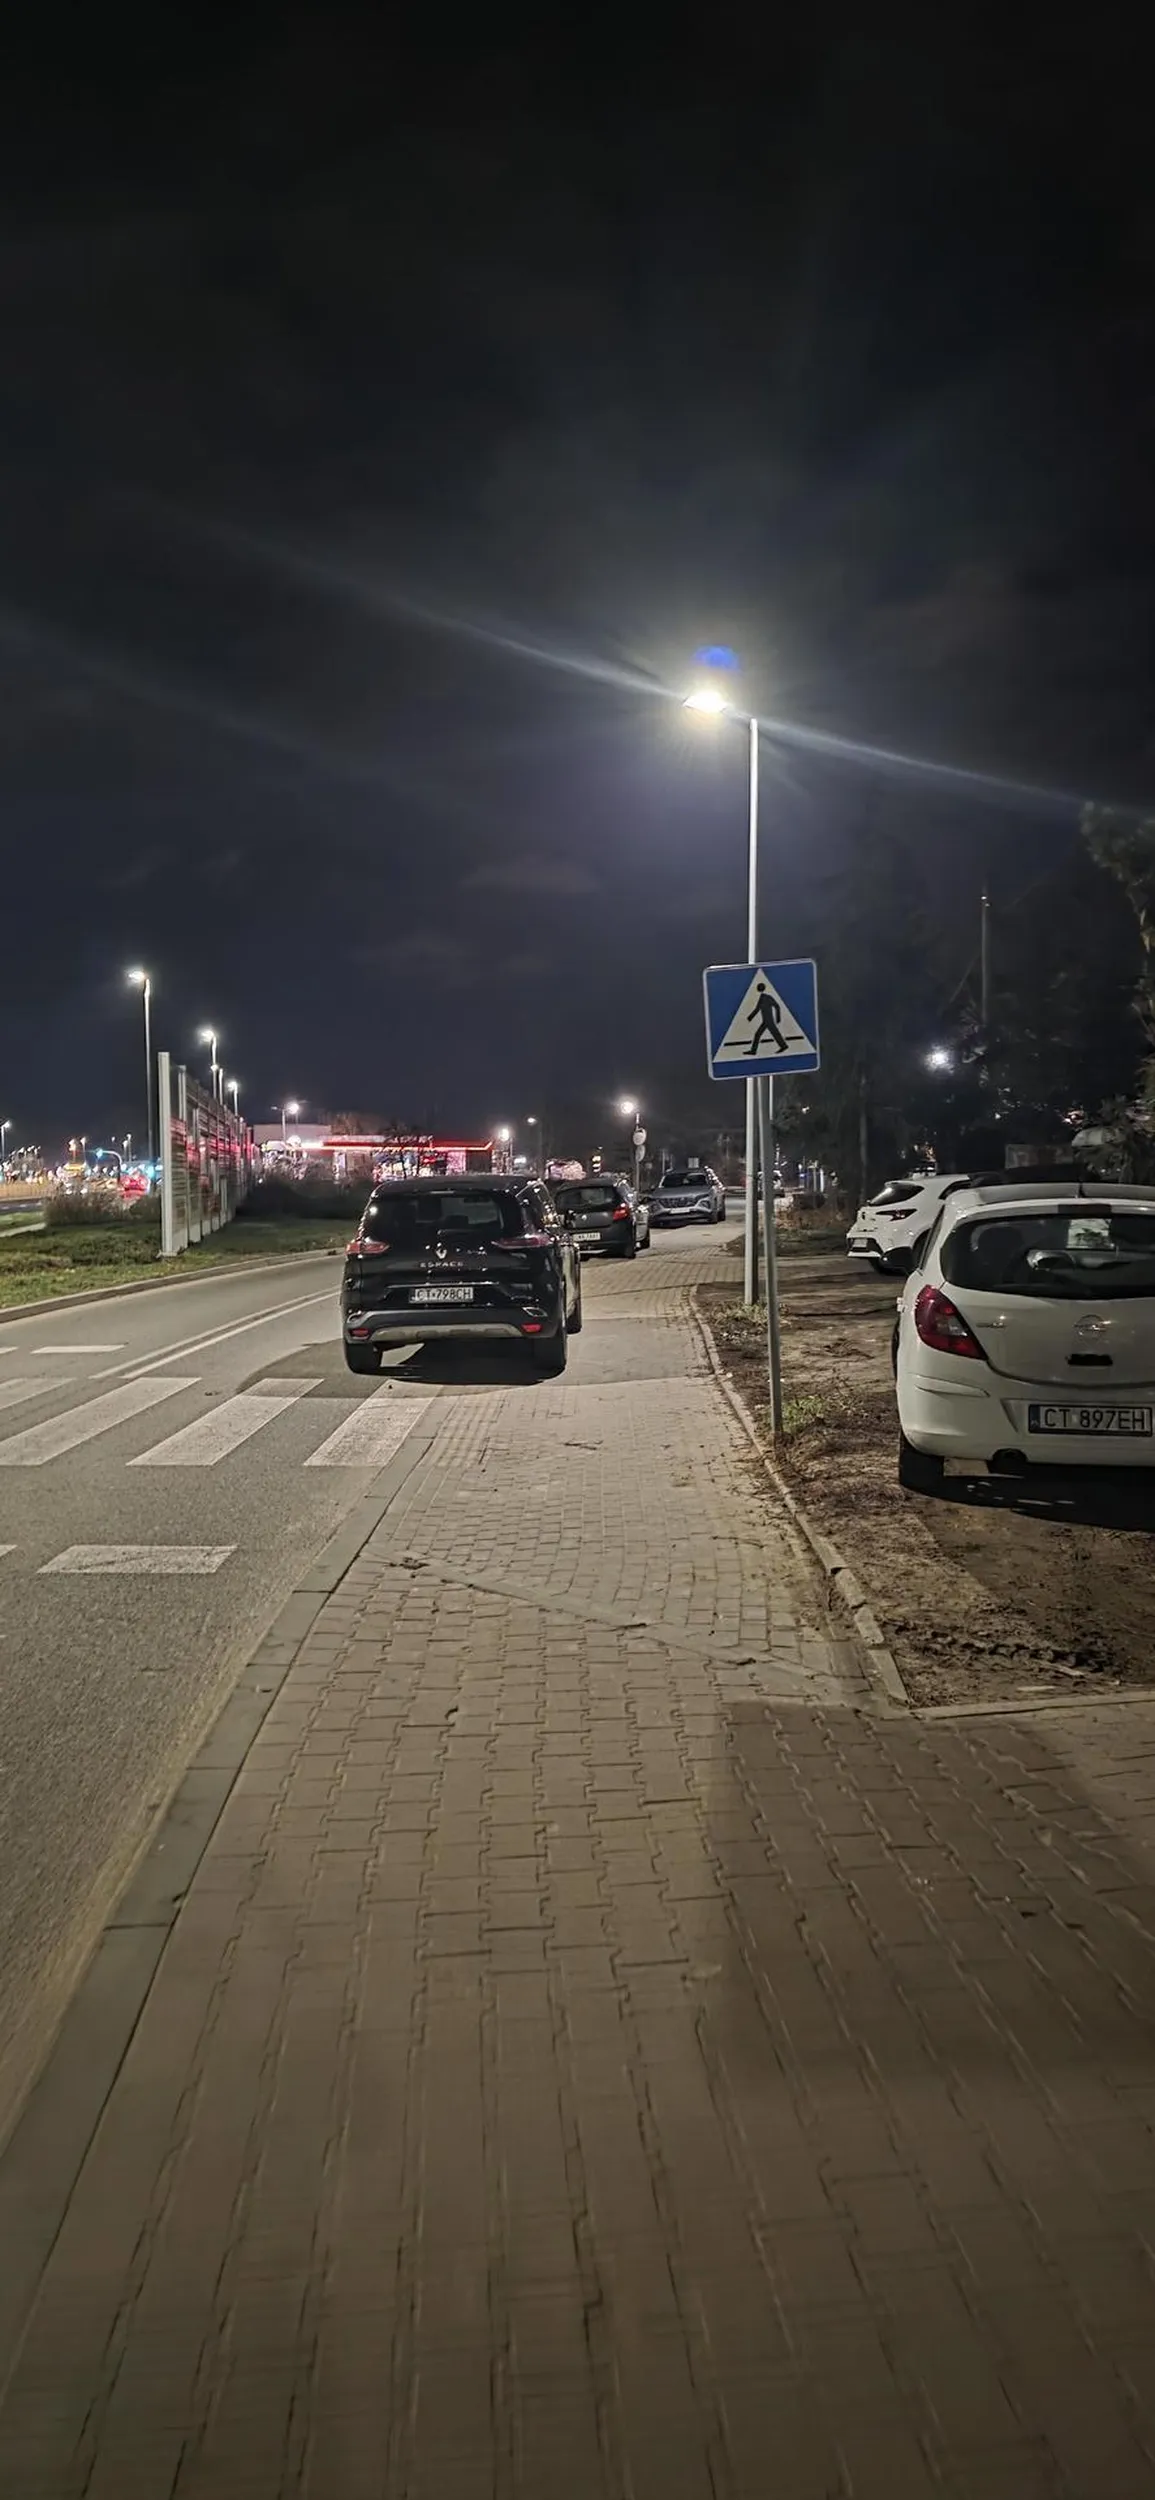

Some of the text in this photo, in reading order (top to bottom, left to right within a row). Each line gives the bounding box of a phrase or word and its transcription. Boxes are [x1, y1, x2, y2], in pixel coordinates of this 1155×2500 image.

[417, 1288, 471, 1300] CT 798CH
[1044, 1408, 1145, 1430] CT 897EH
